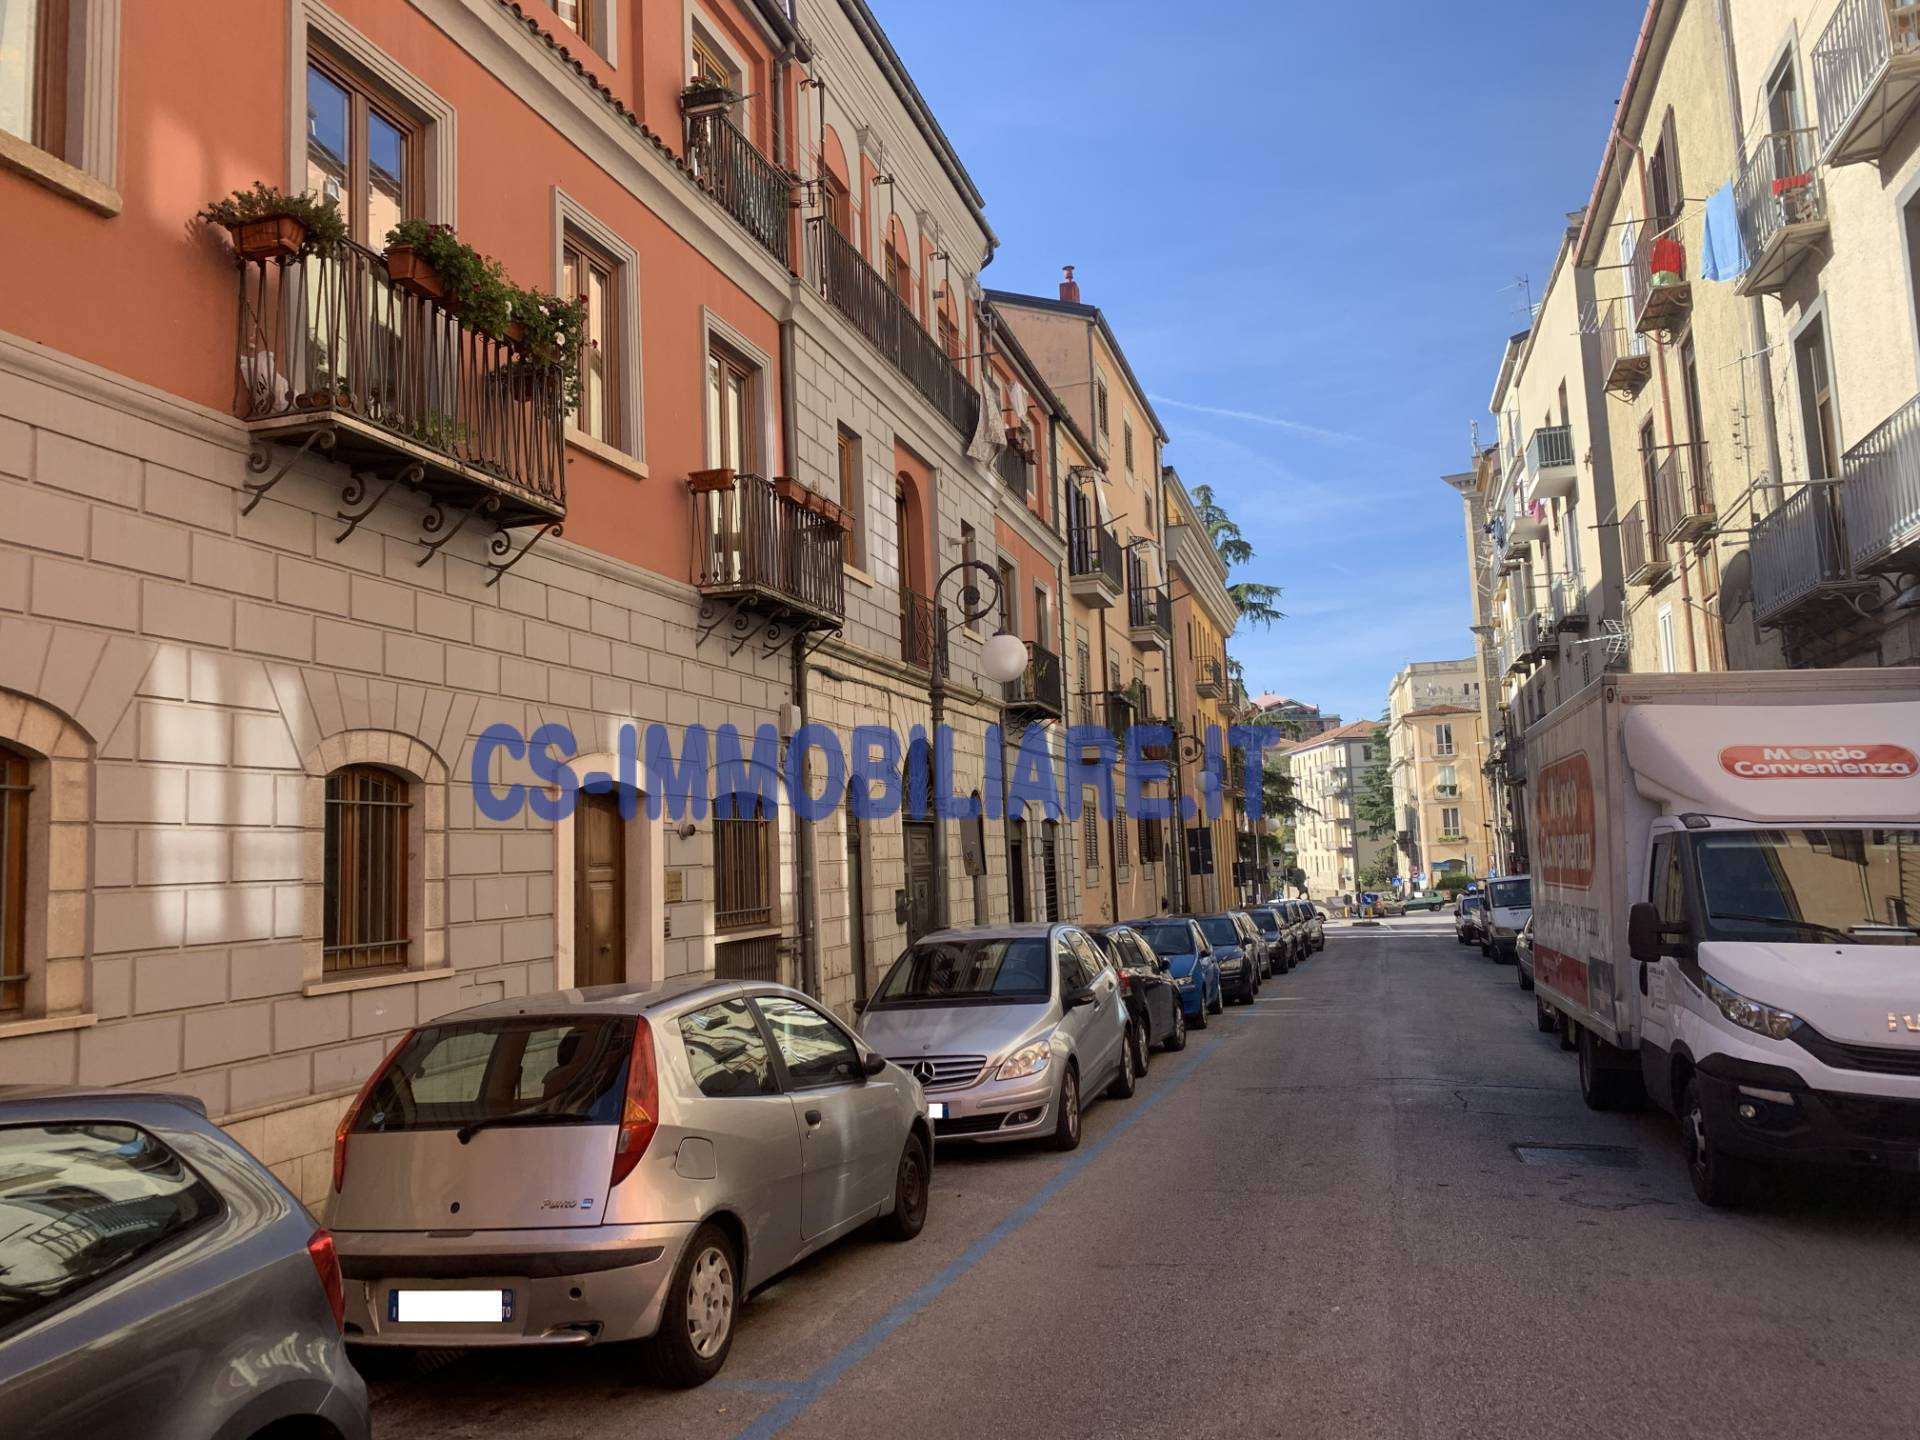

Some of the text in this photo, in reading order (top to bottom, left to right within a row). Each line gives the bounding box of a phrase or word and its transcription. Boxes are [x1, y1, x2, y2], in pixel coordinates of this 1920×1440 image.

[1763, 746, 1867, 761] Mondo
[1734, 760, 1911, 775] Convenienza
[540, 1199, 577, 1210] Punto
